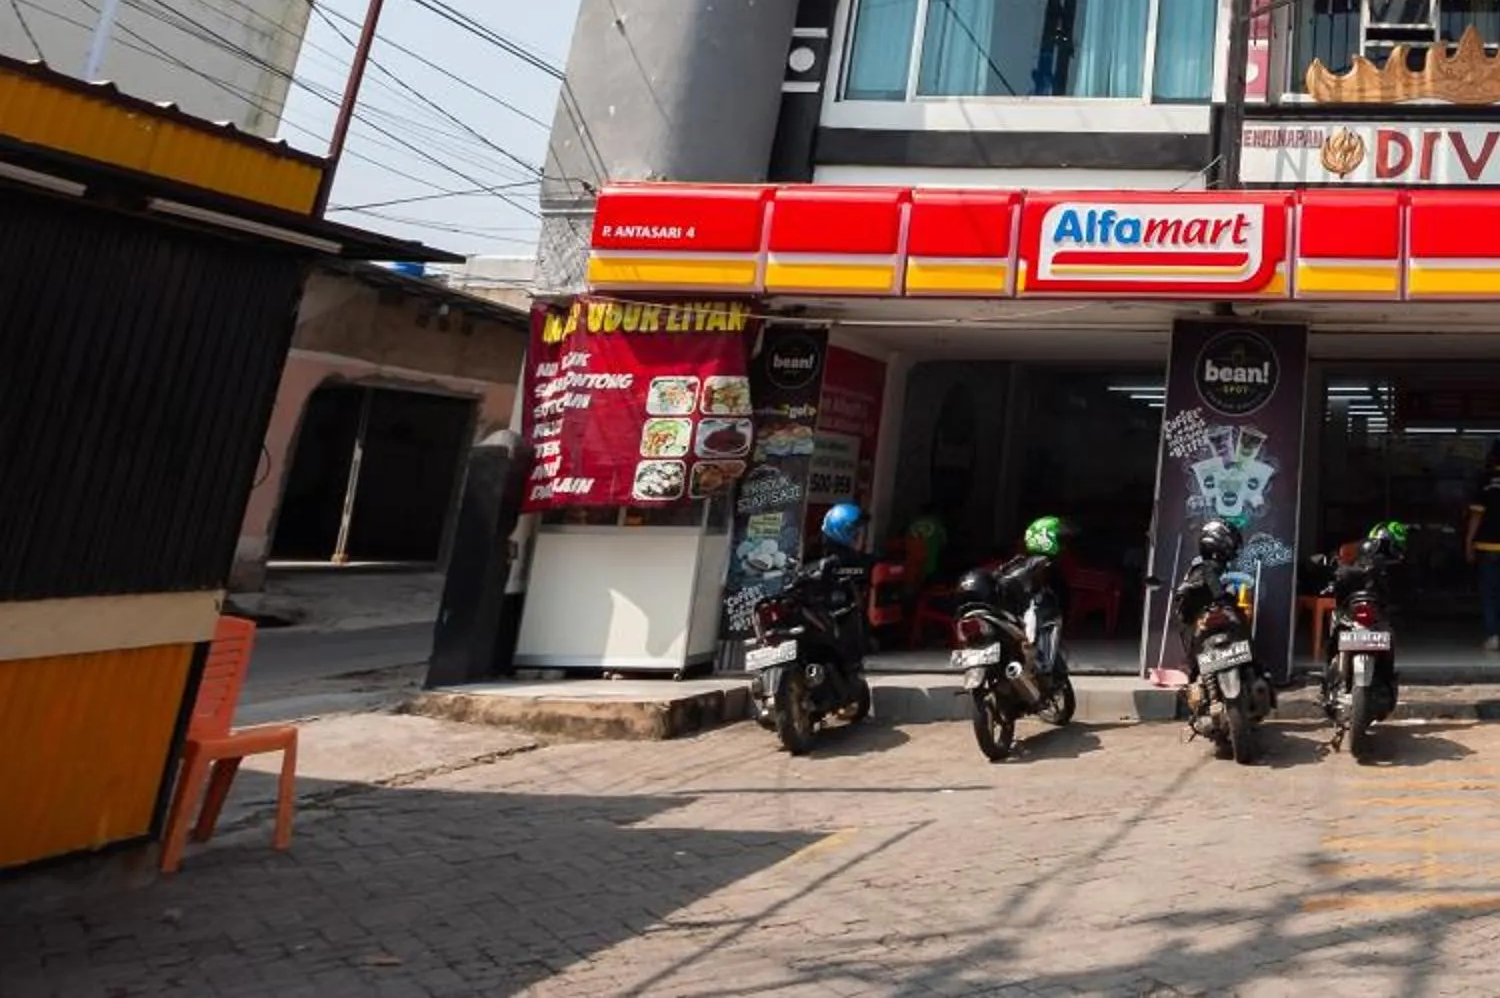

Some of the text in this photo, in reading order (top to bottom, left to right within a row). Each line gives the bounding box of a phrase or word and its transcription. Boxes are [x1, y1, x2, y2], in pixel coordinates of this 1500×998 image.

[1243, 129, 1323, 149] ENGINAPAN
[614, 226, 682, 239] ANTASARI
[1053, 209, 1250, 245] Alfamart
[1205, 359, 1269, 383] bean!
